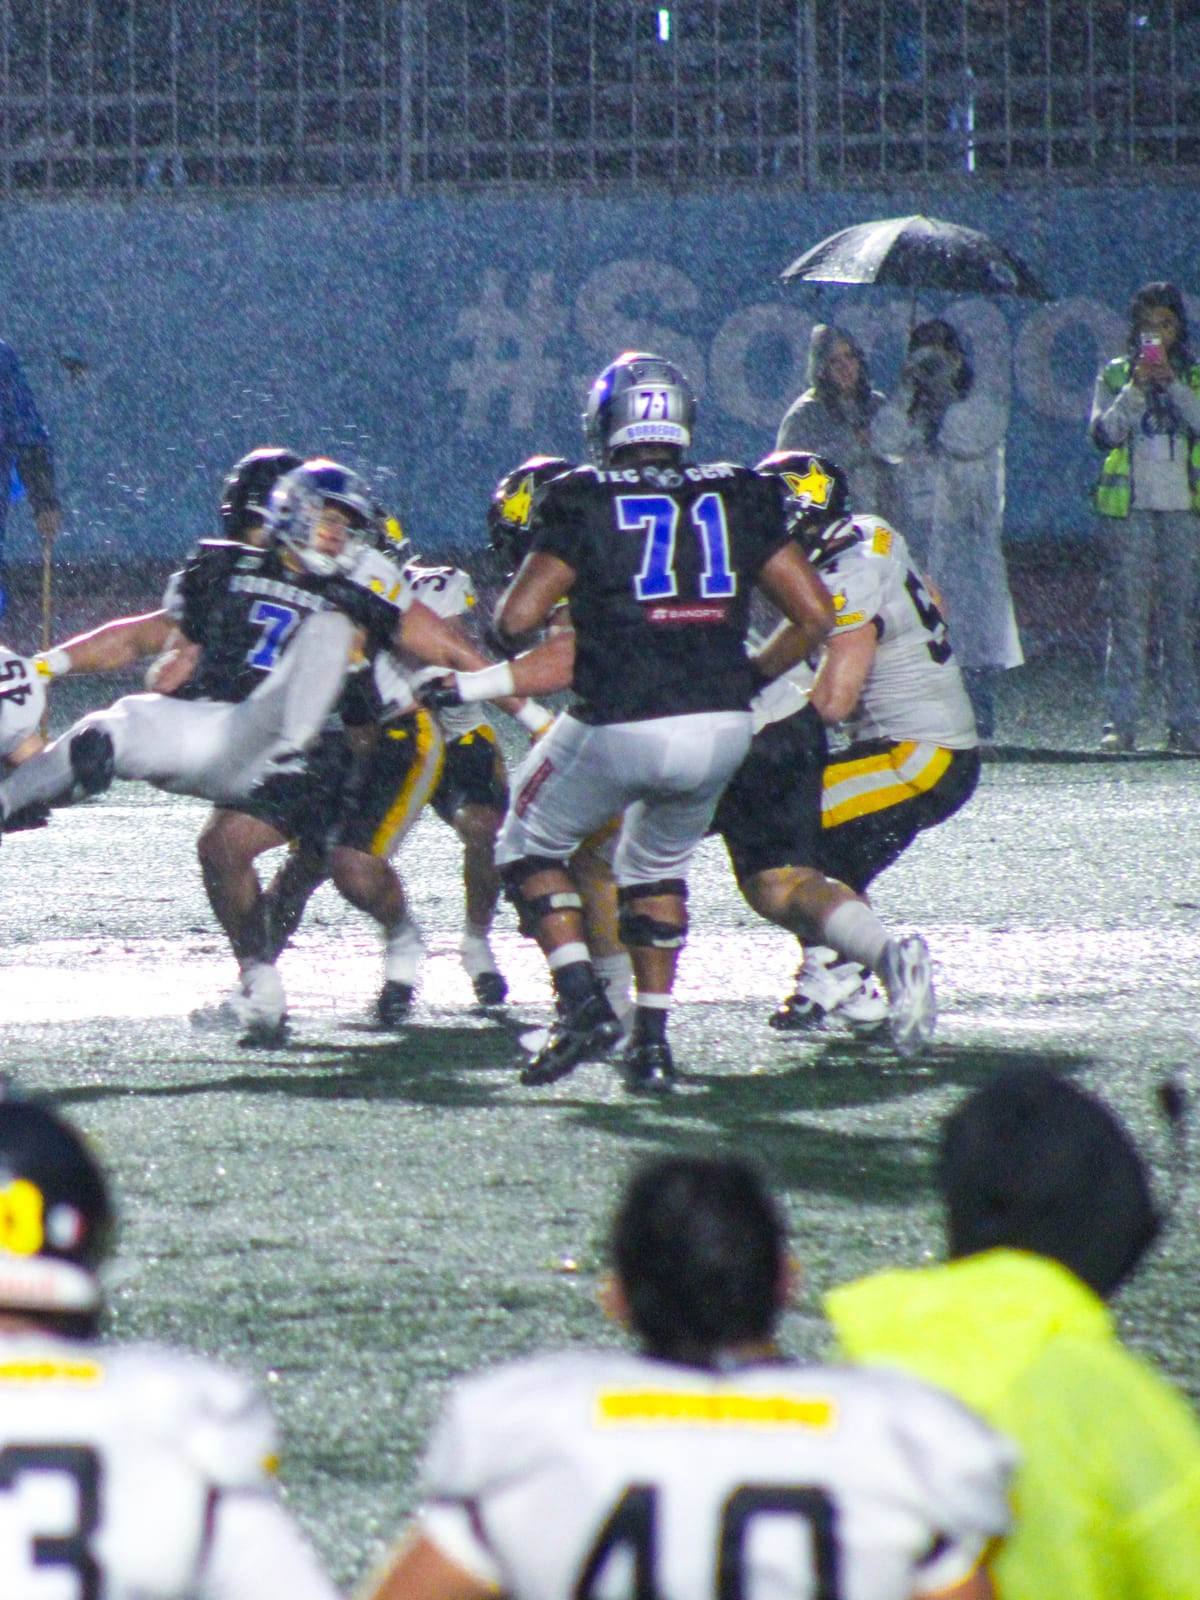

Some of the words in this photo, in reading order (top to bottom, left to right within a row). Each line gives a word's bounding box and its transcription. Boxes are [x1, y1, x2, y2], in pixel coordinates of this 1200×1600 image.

[640, 392, 668, 420] 71
[596, 467, 640, 483] TEC
[615, 492, 737, 600] 71
[573, 1483, 842, 1600] 40
